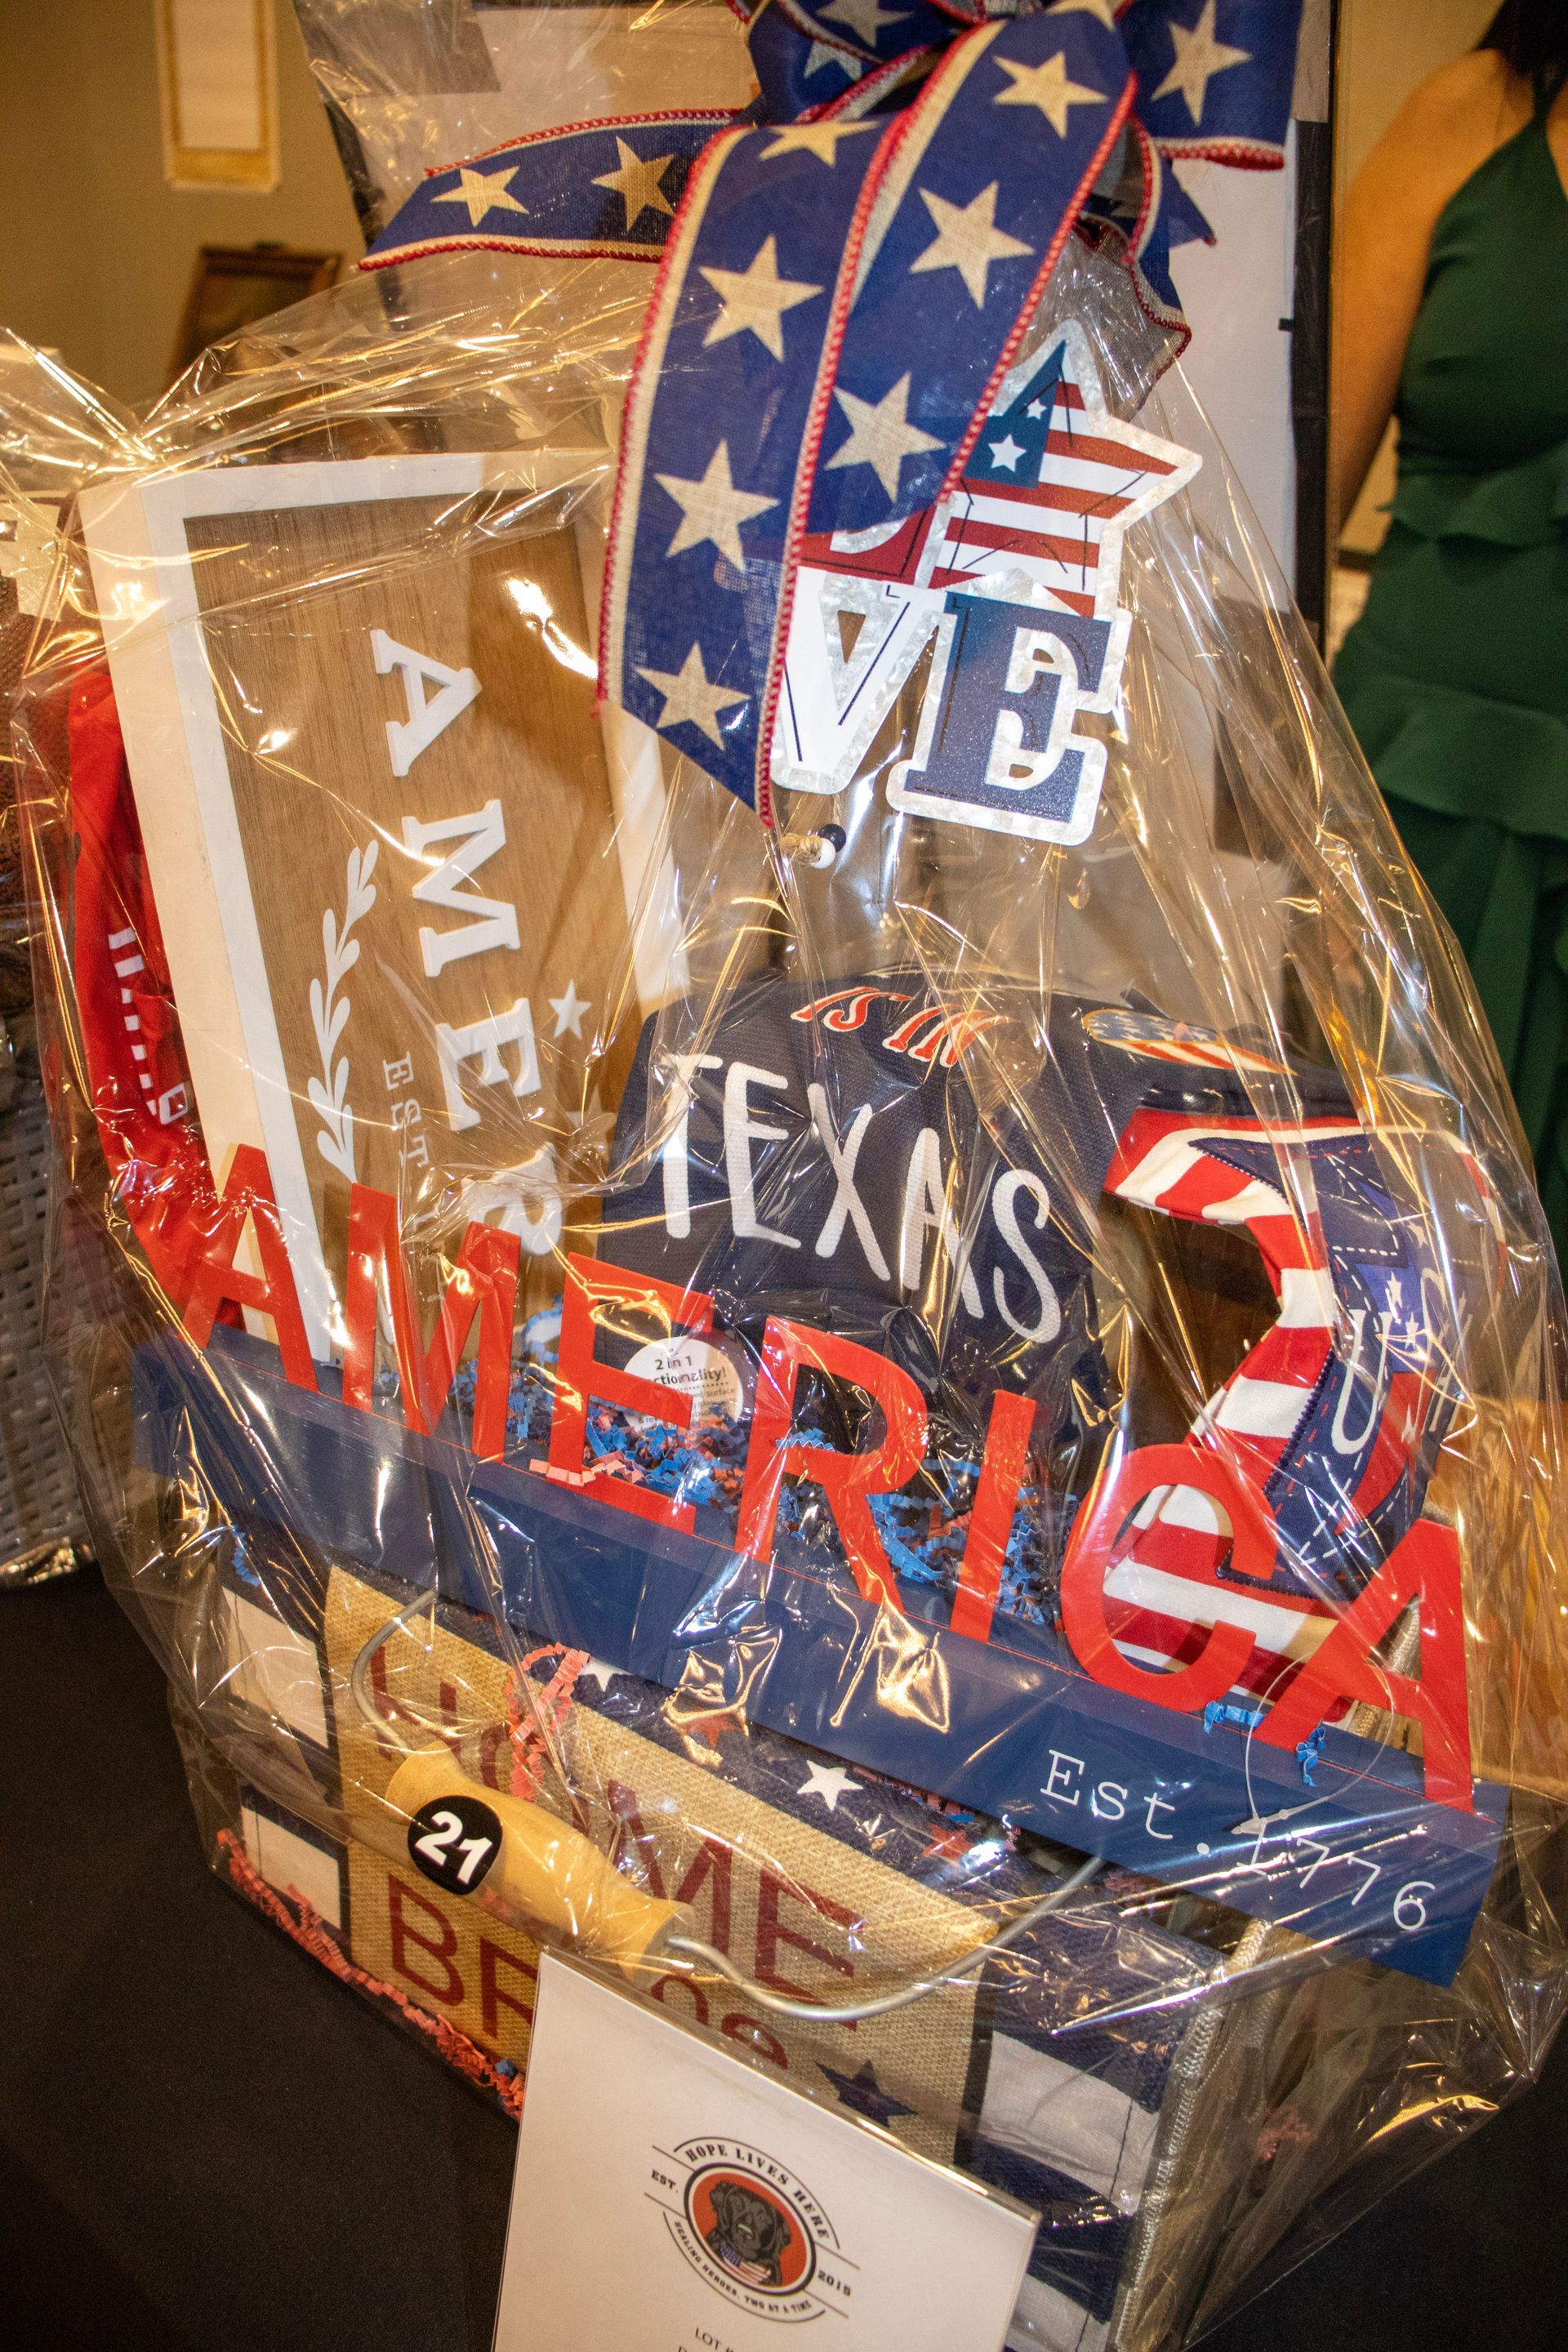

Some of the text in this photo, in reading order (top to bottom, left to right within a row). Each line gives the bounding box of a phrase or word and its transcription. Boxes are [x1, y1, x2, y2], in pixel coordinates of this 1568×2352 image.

[658, 1053, 1062, 1344] TEXAS
[654, 1356, 692, 1370] 2 in 1
[181, 1143, 1475, 1813] AMERICA
[414, 1811, 492, 1884] 21
[651, 2169, 679, 2194] EST.
[684, 2144, 831, 2242] HOPE LIVES HERE
[675, 2221, 702, 2263] HEALING
[744, 2295, 765, 2310] TWO
[791, 2300, 812, 2314] TIME
[695, 2326, 722, 2351] LOT
